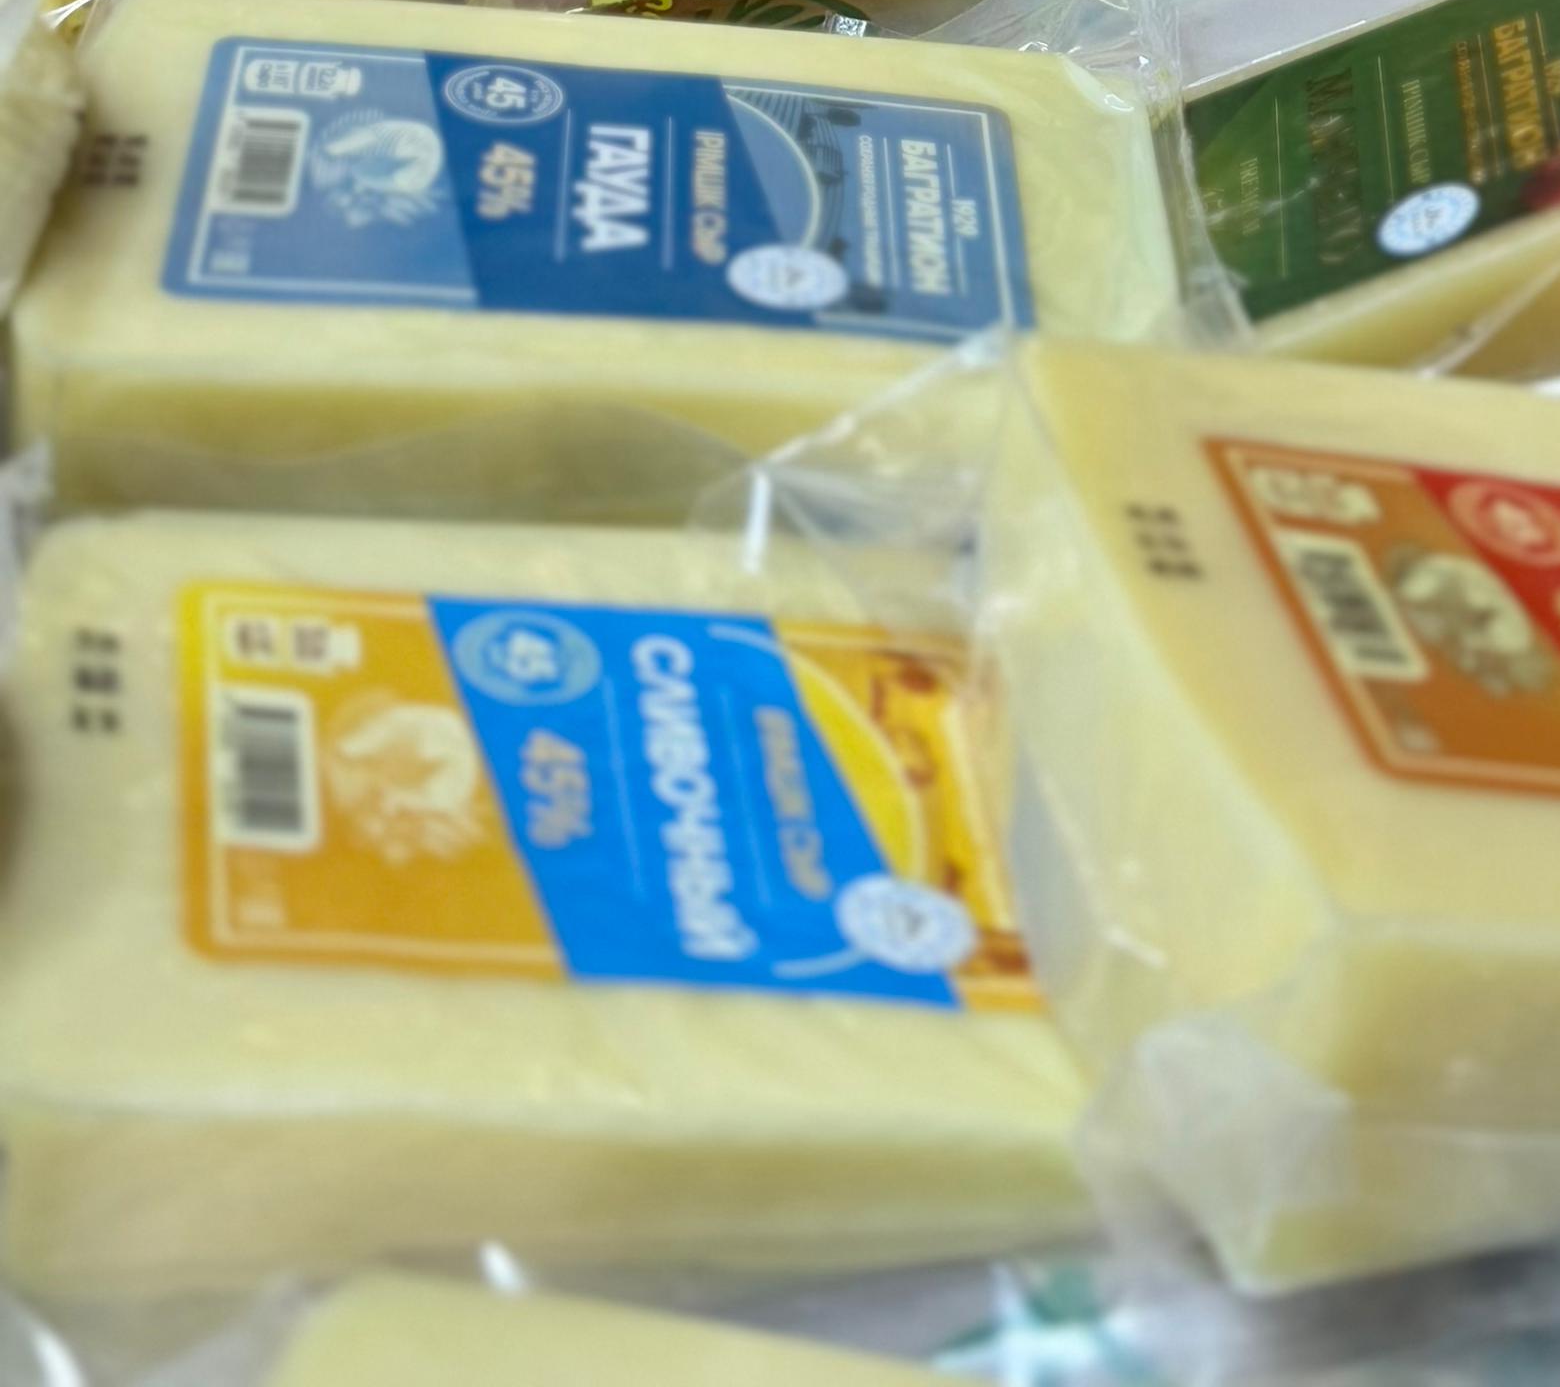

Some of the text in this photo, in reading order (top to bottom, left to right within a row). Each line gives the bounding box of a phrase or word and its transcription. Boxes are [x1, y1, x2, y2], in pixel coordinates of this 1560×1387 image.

[486, 77, 525, 110] 45
[1493, 18, 1544, 171] БАГРАТИОН
[477, 142, 535, 219] 45%
[573, 124, 650, 251] ГАУДА
[900, 137, 951, 295] БАГРАТИОН
[631, 634, 758, 963] СЛИВОЧНЫЙ
